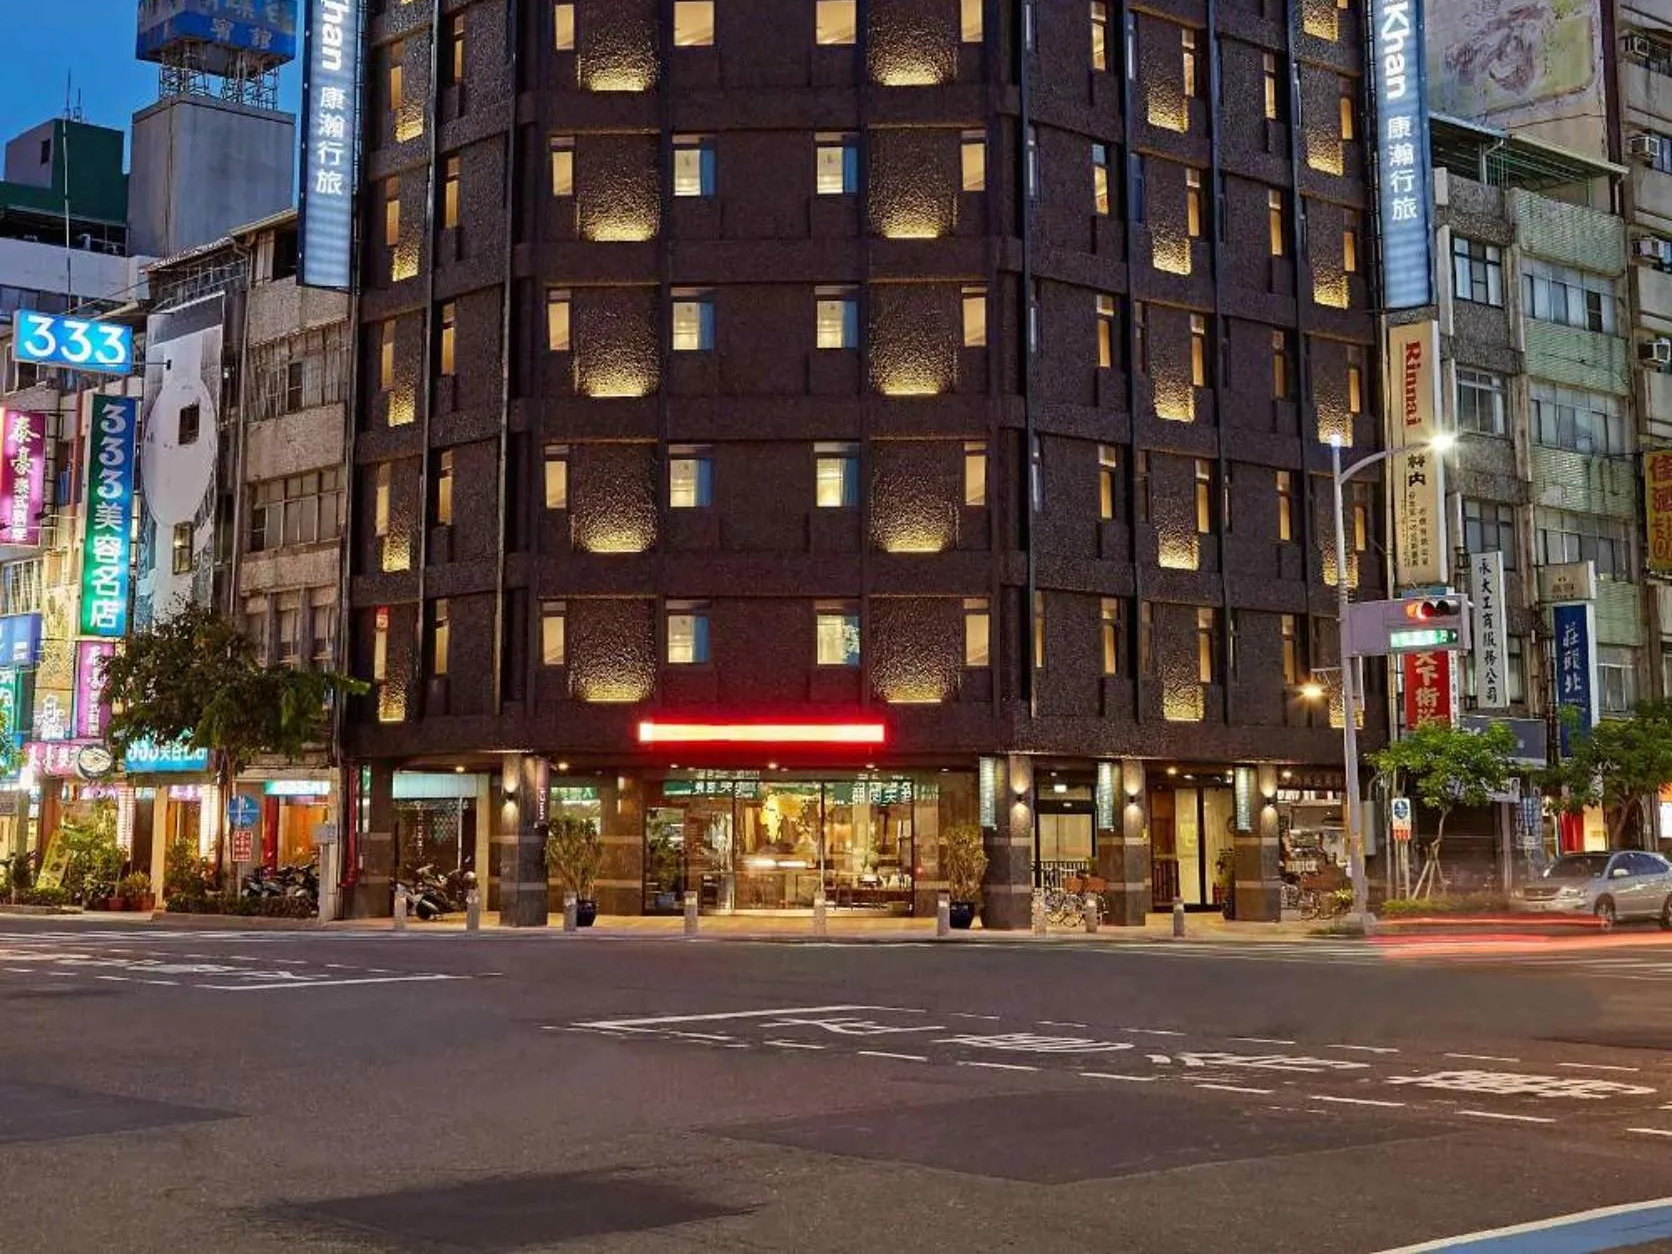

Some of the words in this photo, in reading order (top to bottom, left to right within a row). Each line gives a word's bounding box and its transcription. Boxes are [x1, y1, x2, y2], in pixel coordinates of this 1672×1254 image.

[1381, 0, 1411, 100] Khan
[316, 86, 346, 196] 康瀚行旅
[1387, 116, 1417, 221] 康瀚行旅
[24, 314, 126, 365] 333
[1405, 342, 1422, 426] Rinnai
